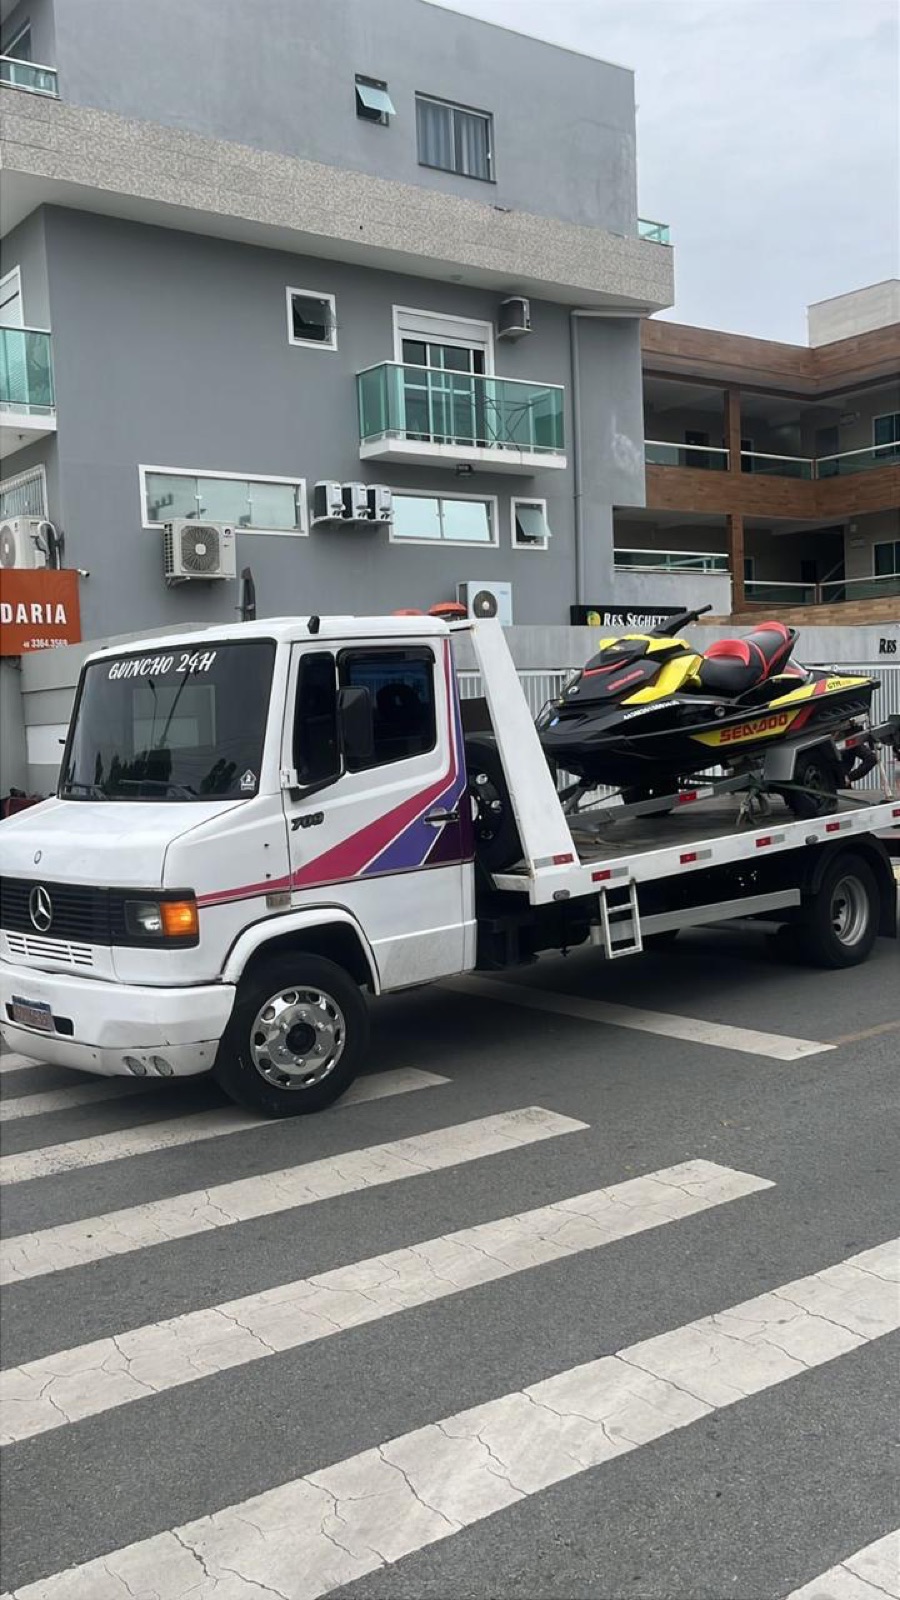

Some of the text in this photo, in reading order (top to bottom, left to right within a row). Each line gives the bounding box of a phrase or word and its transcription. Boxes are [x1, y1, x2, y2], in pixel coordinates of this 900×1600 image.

[0, 602, 67, 624] DARIA
[108, 651, 217, 680] GUINCHO 24H
